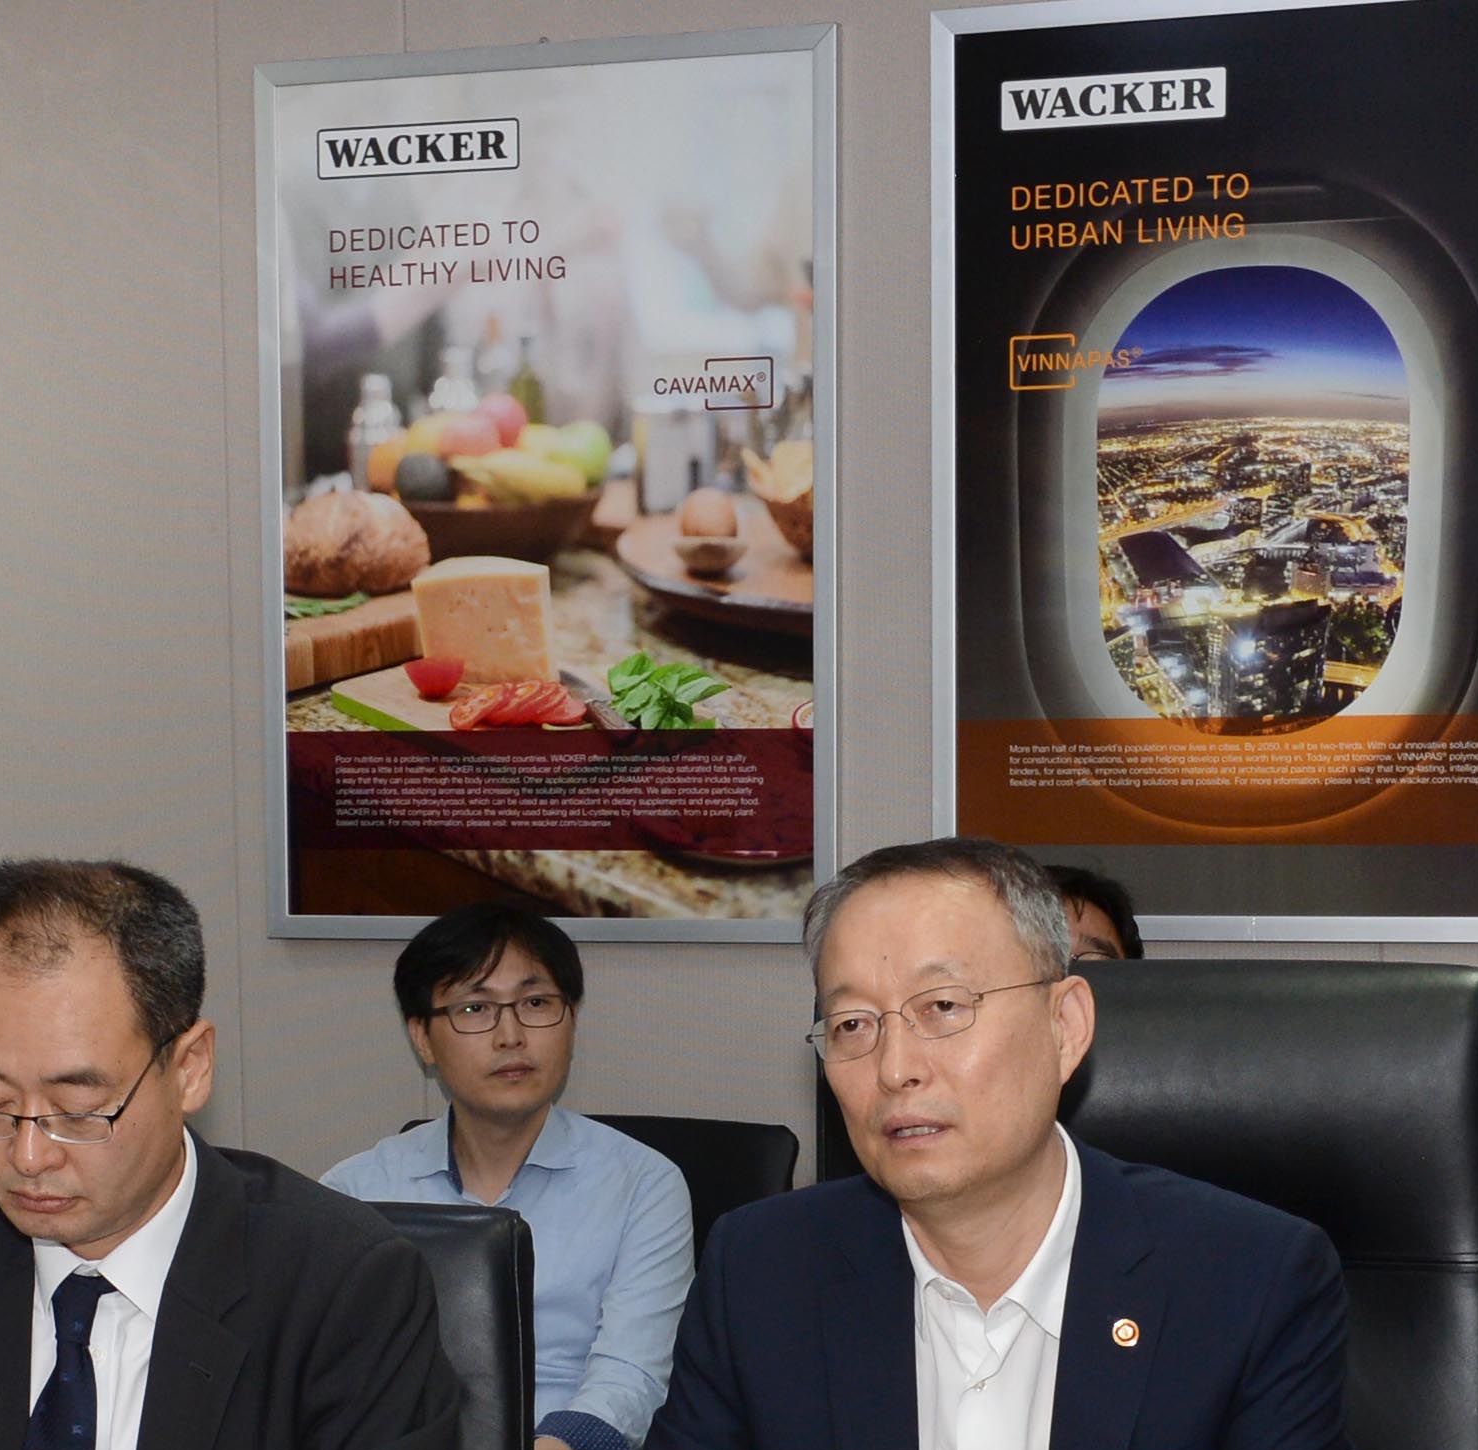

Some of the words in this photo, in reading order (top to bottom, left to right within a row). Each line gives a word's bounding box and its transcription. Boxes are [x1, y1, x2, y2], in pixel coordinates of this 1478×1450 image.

[1009, 77, 1215, 121] WACKER
[325, 128, 509, 169] WACKER
[1011, 176, 1194, 211] DEDICATED
[1206, 172, 1250, 201] TO
[328, 222, 491, 254] DEDICATED
[502, 219, 541, 246] TO
[1011, 219, 1124, 250] URBAN
[1137, 213, 1247, 245] LIVING
[329, 260, 458, 290] HEALTHY
[471, 255, 567, 284] LIVING
[653, 370, 768, 396] CAVAMAX®
